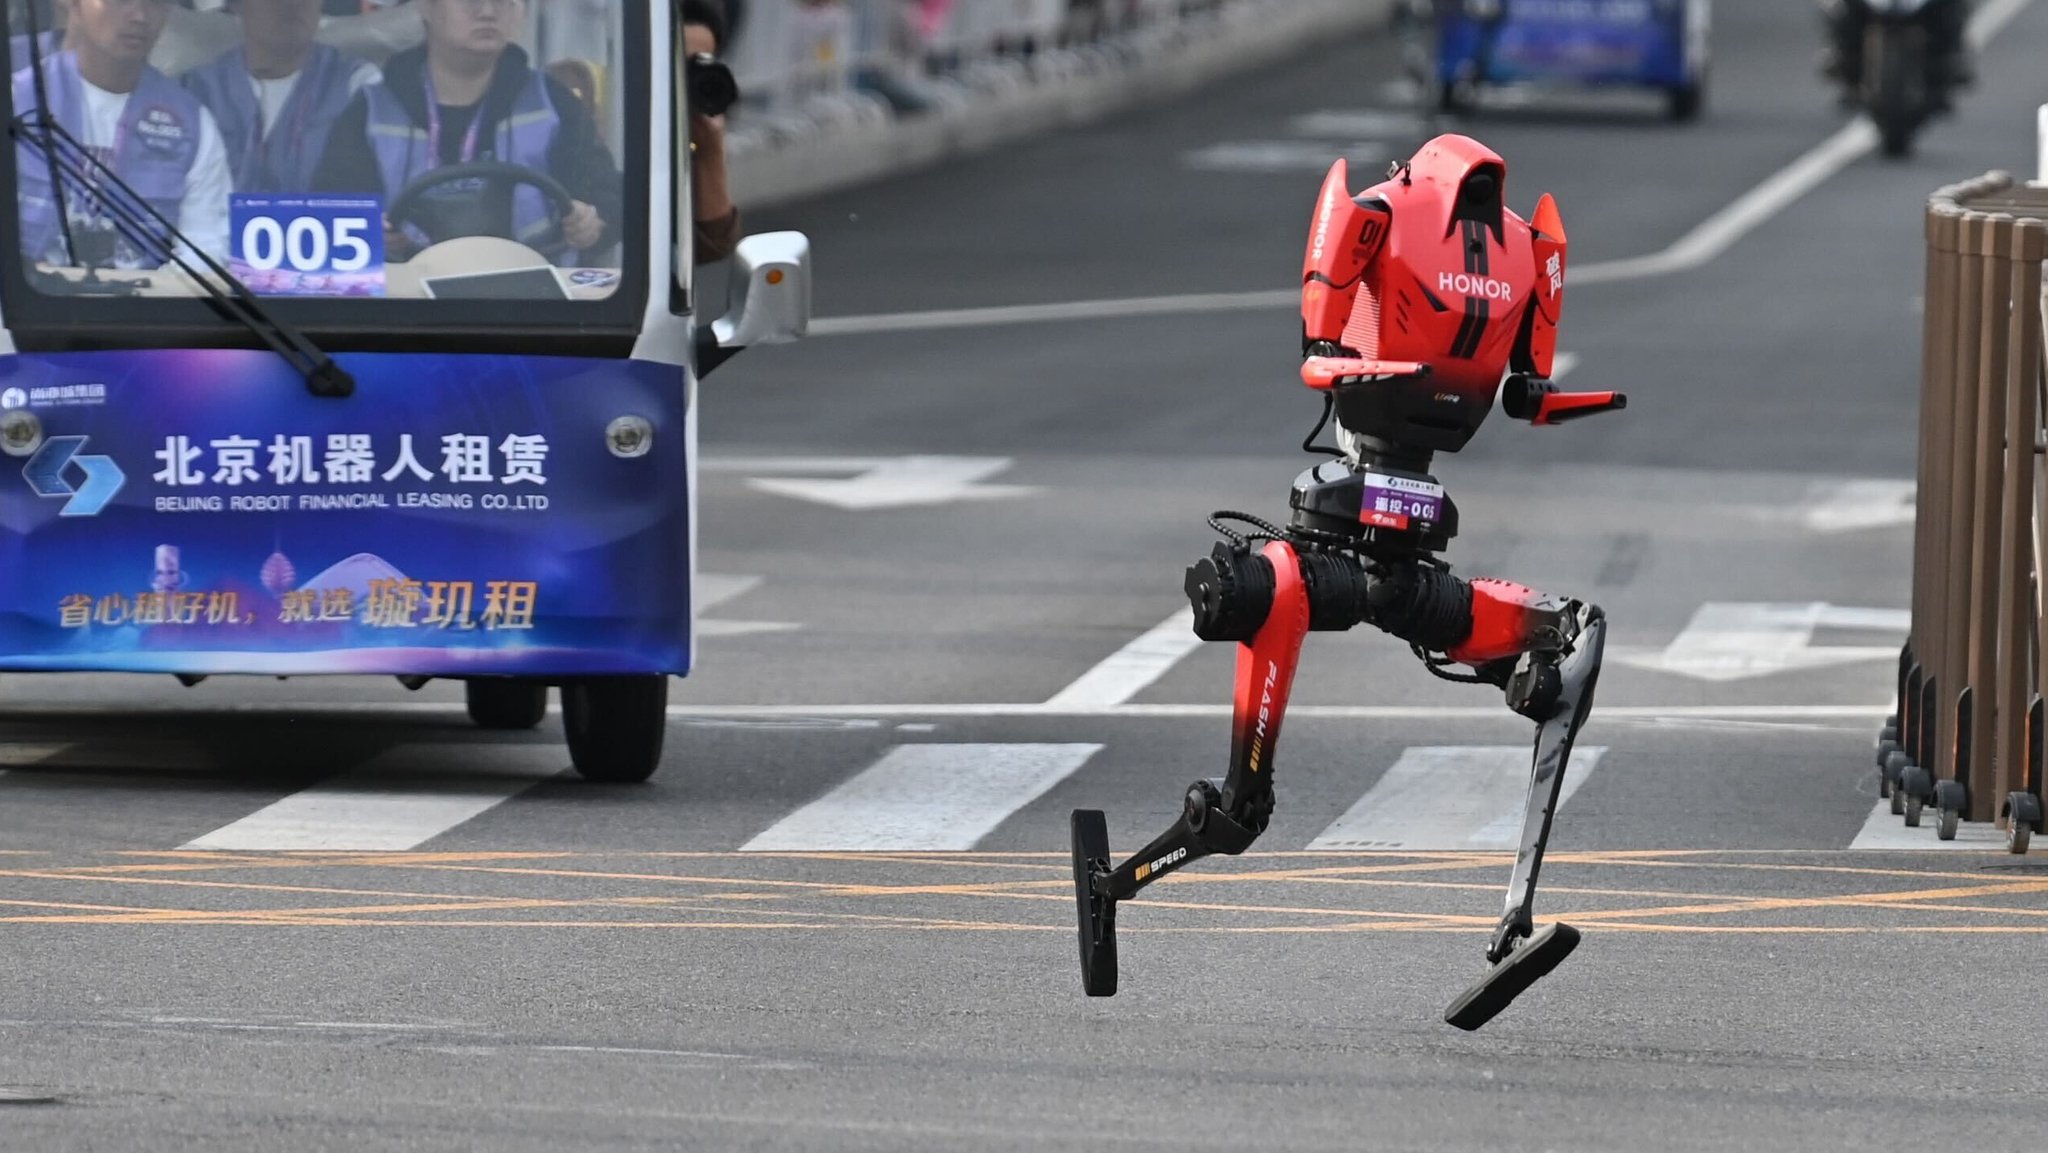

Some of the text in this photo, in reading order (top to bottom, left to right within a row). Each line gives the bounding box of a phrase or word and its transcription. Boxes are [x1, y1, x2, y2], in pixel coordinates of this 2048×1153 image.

[242, 216, 371, 271] 005
[1439, 272, 1512, 302] HONOR
[153, 432, 549, 486] 北京机器人租赁
[155, 495, 223, 512] BEIJING
[230, 495, 290, 511] ROBOT
[300, 493, 390, 510] FINANCIAL
[397, 492, 473, 509] LEASING
[1256, 660, 1277, 738] FLASH
[1151, 847, 1187, 873] SPEED
